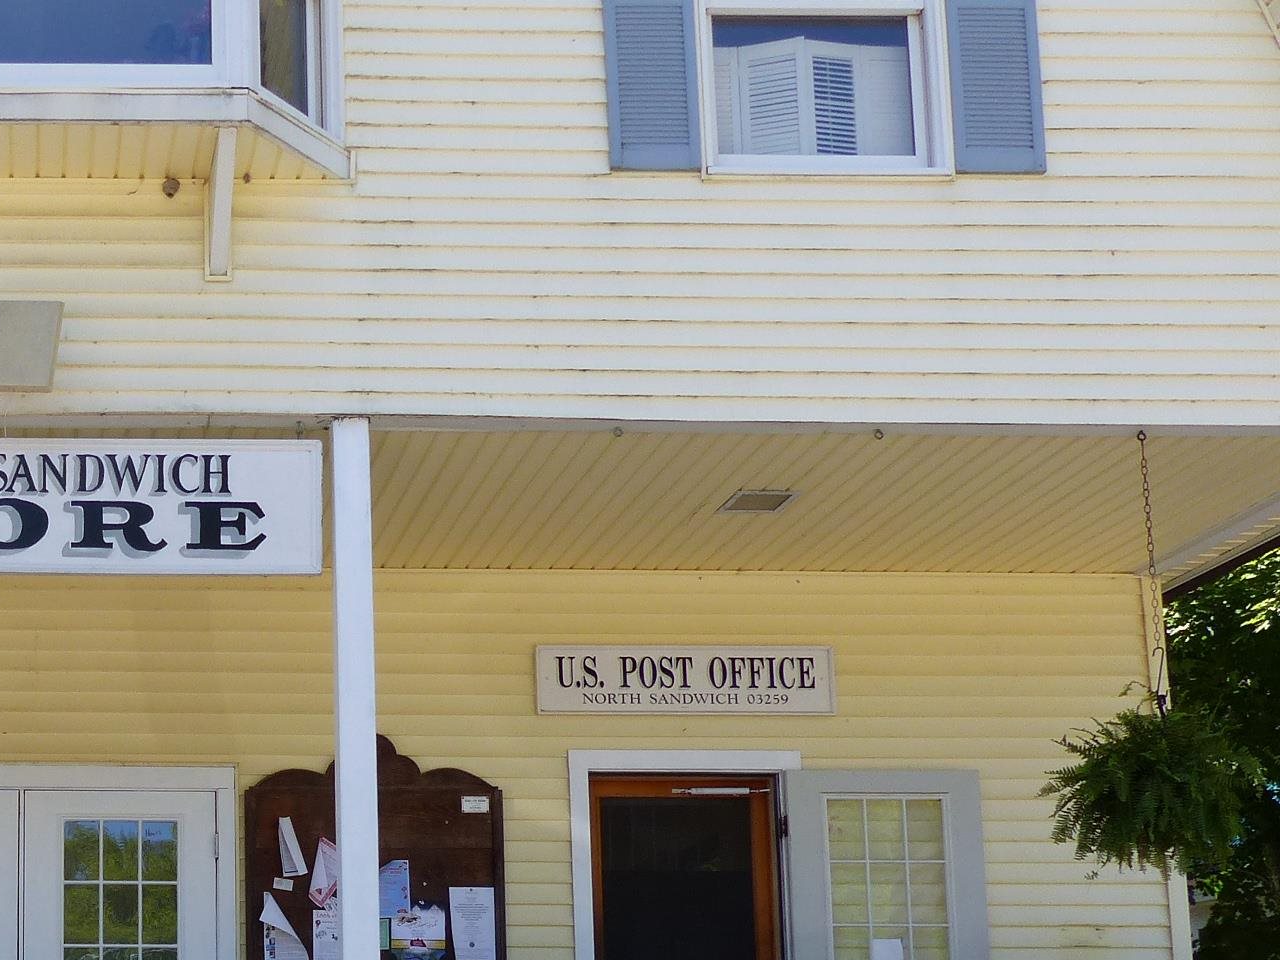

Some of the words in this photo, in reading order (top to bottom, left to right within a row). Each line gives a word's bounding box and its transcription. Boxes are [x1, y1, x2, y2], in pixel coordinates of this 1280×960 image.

[555, 655, 605, 688] U.S.
[619, 656, 693, 689] POST
[708, 656, 816, 690] OFFICE
[582, 693, 641, 705] NORTH
[649, 693, 739, 705] SANDWICH
[746, 693, 789, 706] 03259
